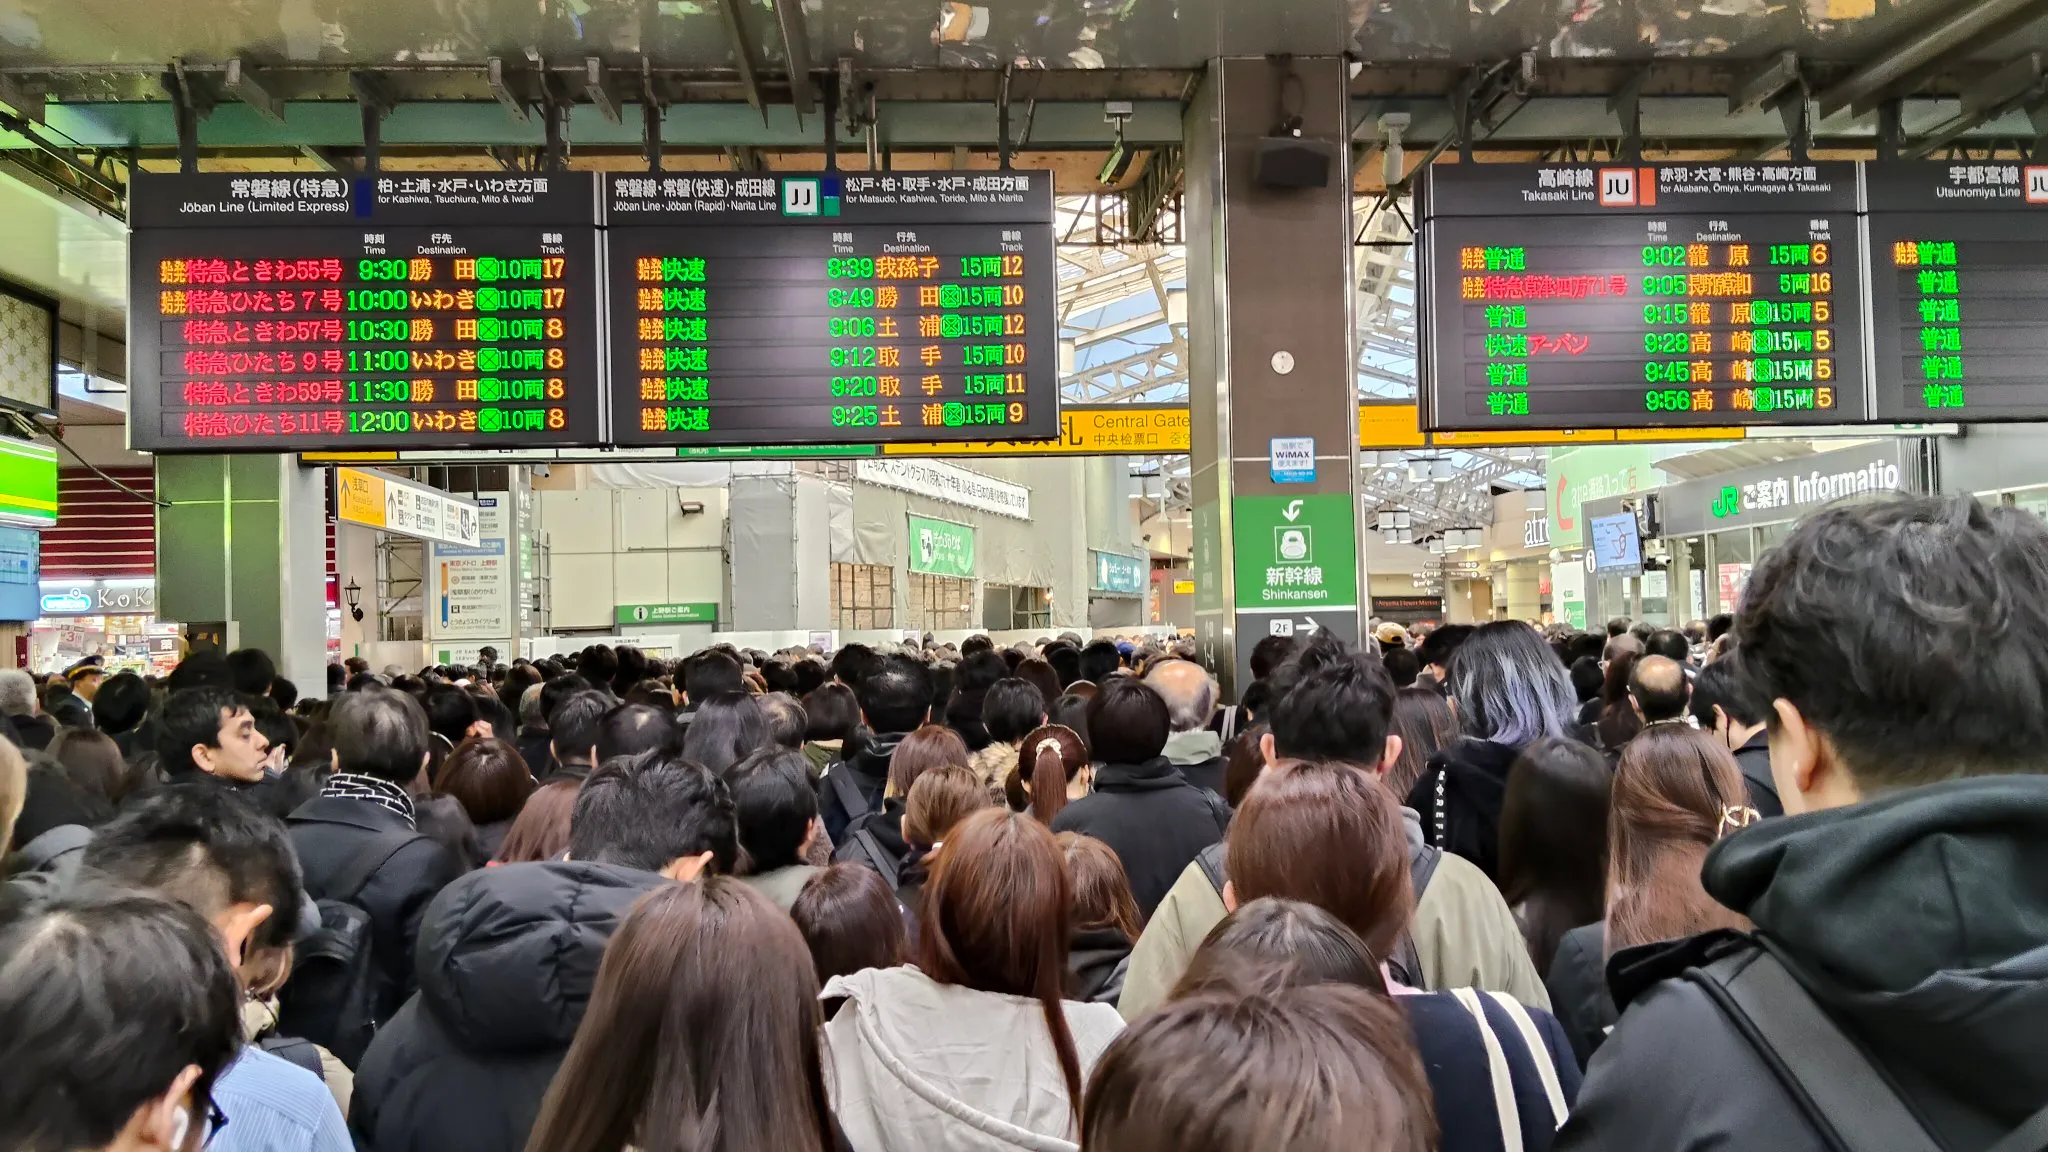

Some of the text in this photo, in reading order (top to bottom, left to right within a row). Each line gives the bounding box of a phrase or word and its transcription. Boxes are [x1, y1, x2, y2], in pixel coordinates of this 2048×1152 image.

[1538, 169, 1593, 187] 高崎線
[1950, 166, 2020, 184] 宇都宮線
[231, 178, 349, 198] 常磐線(特急)
[378, 178, 547, 194] 柏・土浦・水戸・いわき方面
[1605, 179, 1629, 195] JU
[1674, 184, 1711, 193] Akabane,
[1744, 184, 1785, 194] Kumagaya
[1937, 187, 2020, 199] Utsunomiya Line
[392, 195, 533, 204] Kashiwa, Tsuchiura, Mito Iwaki
[791, 190, 810, 205] JJ
[860, 194, 1023, 205] Matsudo, Kashiwa, Toride, Mito Narita
[1522, 189, 1594, 201] Takasaki Line
[180, 200, 349, 213] Jōban Line (Limited Express)
[614, 200, 776, 212] Jōban Line
[1648, 222, 1667, 232] 時刻
[1709, 221, 1727, 231] 行先
[1810, 220, 1829, 230] 番線
[364, 234, 384, 245] 時刻
[432, 234, 452, 245] 行先
[542, 234, 563, 245] 番線
[833, 232, 852, 243] 時刻
[897, 232, 915, 242] 行先
[1002, 231, 1021, 241] 番線
[1697, 232, 1740, 241] Destination
[1809, 231, 1830, 240] Track
[364, 246, 386, 254] Time
[417, 246, 466, 255] Destination
[541, 246, 564, 254] Track
[833, 244, 853, 253] Time
[884, 244, 929, 252] Destination
[1001, 243, 1023, 251] Track
[1894, 241, 1956, 265] 始発 普通
[1461, 244, 1827, 272] 始発 普通 9:02 6
[160, 260, 189, 284] 始発
[360, 260, 406, 280] 9:30
[544, 258, 564, 278] 17
[638, 258, 662, 280] 始発
[661, 258, 705, 281] 快速
[827, 258, 873, 279] 8:39
[876, 256, 939, 279] 我孫子
[1003, 256, 1022, 275] 12
[1461, 277, 1486, 300] 始発
[1642, 275, 1687, 296] 9:05
[1812, 273, 1831, 292] 16
[1917, 270, 1960, 294] 普通
[161, 291, 189, 314] 始発
[348, 290, 407, 310] 10:00
[411, 289, 475, 309] いわき
[544, 288, 564, 308] 17
[638, 288, 663, 311] 始発
[662, 288, 706, 311] 快速
[827, 288, 874, 308] 8:49
[1004, 285, 1023, 305] 10
[1485, 301, 1829, 328] 普通 9:15 5
[1919, 298, 1960, 323] 普通
[348, 320, 408, 340] 10:30
[547, 318, 563, 338] 8
[639, 314, 1024, 341] 始発 快速 9:06 12
[1485, 334, 1528, 358] 快速
[1529, 335, 1588, 354] アーバン
[1644, 333, 1689, 353] 9:28
[1814, 331, 1830, 350] 5
[1920, 327, 1961, 352] 普通
[349, 351, 408, 371] 11:00
[412, 350, 476, 370] いわき
[548, 349, 563, 368] 8
[640, 344, 1024, 371] 始発 快速 9:12 10
[1486, 360, 1831, 386] 普通 9:45 5
[1921, 356, 1963, 380] 普通
[349, 381, 408, 401] 11:30
[548, 378, 564, 398] 8
[641, 374, 1024, 400] 始発 快速 9:20 11
[1486, 389, 1831, 415] 普通 9:56 5
[1922, 384, 1965, 409] 普通
[349, 411, 409, 432] 12:00
[413, 410, 477, 431] いわき
[549, 409, 564, 428] 8
[642, 403, 1023, 430] 始発 快速 9:25 9
[1094, 415, 1189, 428] Central Gate
[1094, 432, 1158, 445] 中央检票口
[1712, 486, 1739, 518] JR
[1743, 477, 1789, 510] ご案内
[1266, 567, 1322, 586] 新幹線
[1262, 589, 1327, 600] Shinkansen
[1275, 623, 1288, 633] 2F
